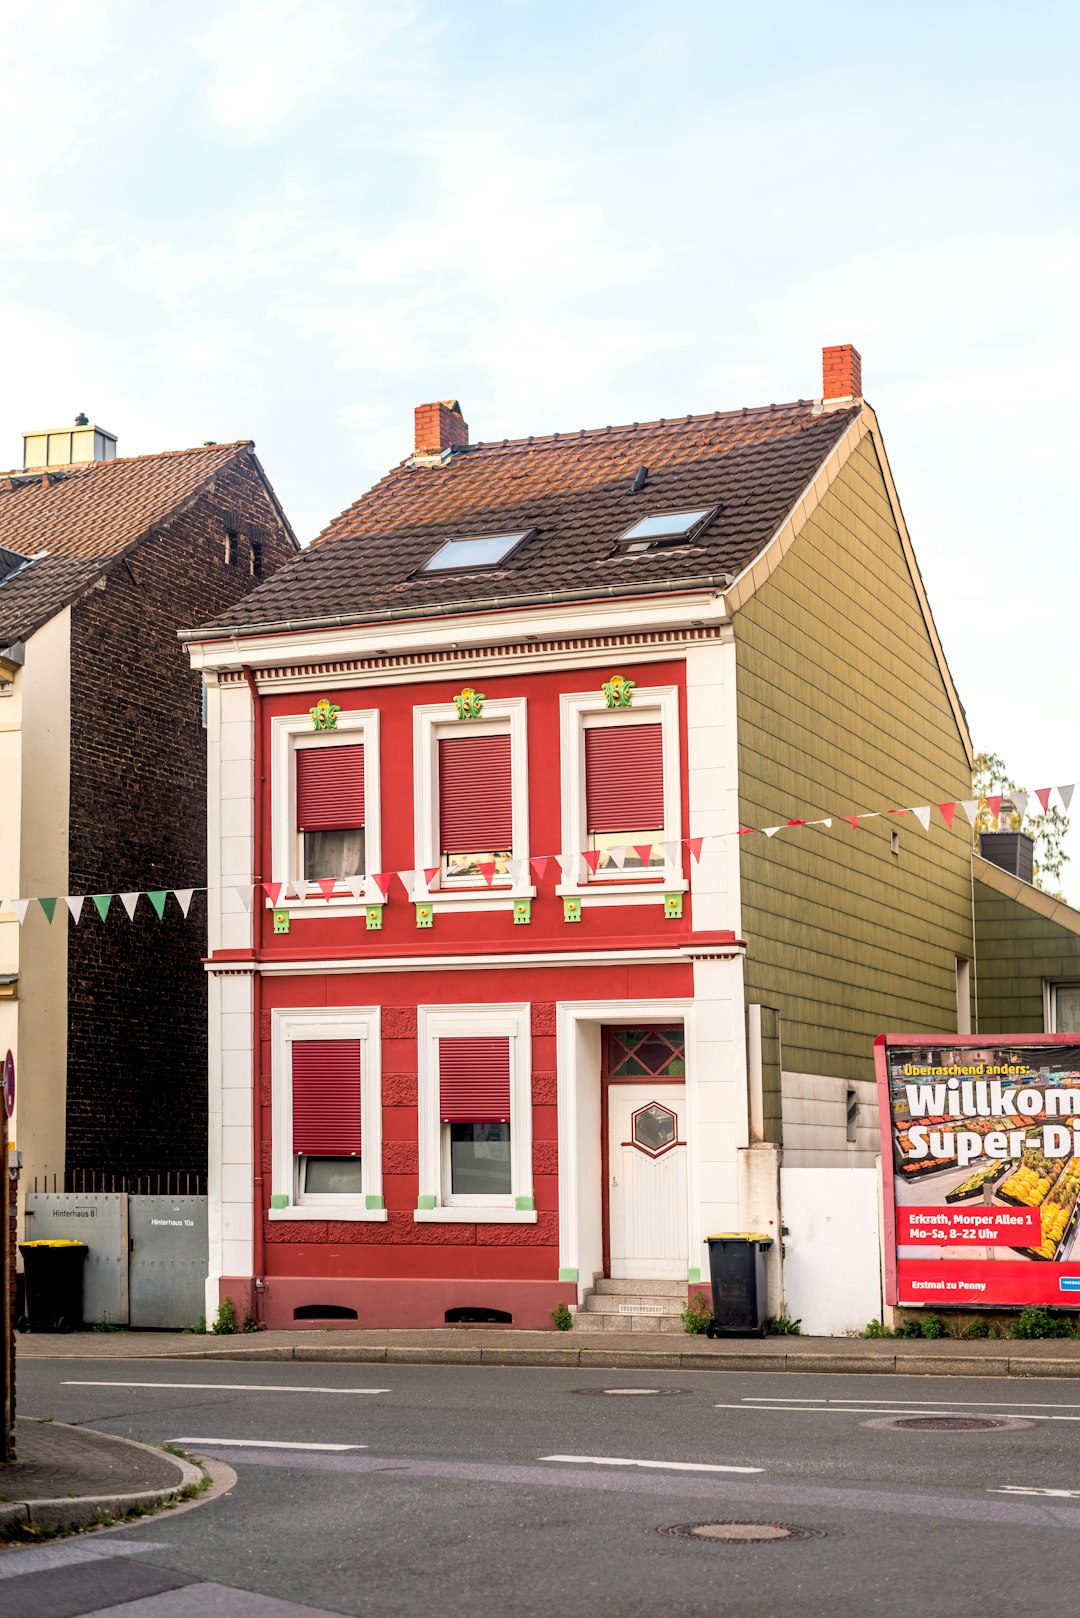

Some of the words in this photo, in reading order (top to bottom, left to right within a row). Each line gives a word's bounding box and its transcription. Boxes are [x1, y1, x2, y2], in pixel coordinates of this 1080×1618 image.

[904, 1063, 984, 1076] Überraschend
[986, 1064, 1030, 1075] anders:
[52, 1209, 89, 1218] Hinterhaus
[90, 1210, 95, 1218] 8
[909, 1214, 952, 1226] Erkrath,
[953, 1215, 994, 1226] Morper
[995, 1215, 1024, 1225] Allee
[1025, 1215, 1033, 1225] 1
[978, 1229, 998, 1239] Uhr
[911, 1280, 945, 1290] Erstmal
[946, 1282, 957, 1290] zu
[958, 1281, 986, 1292] Penny
